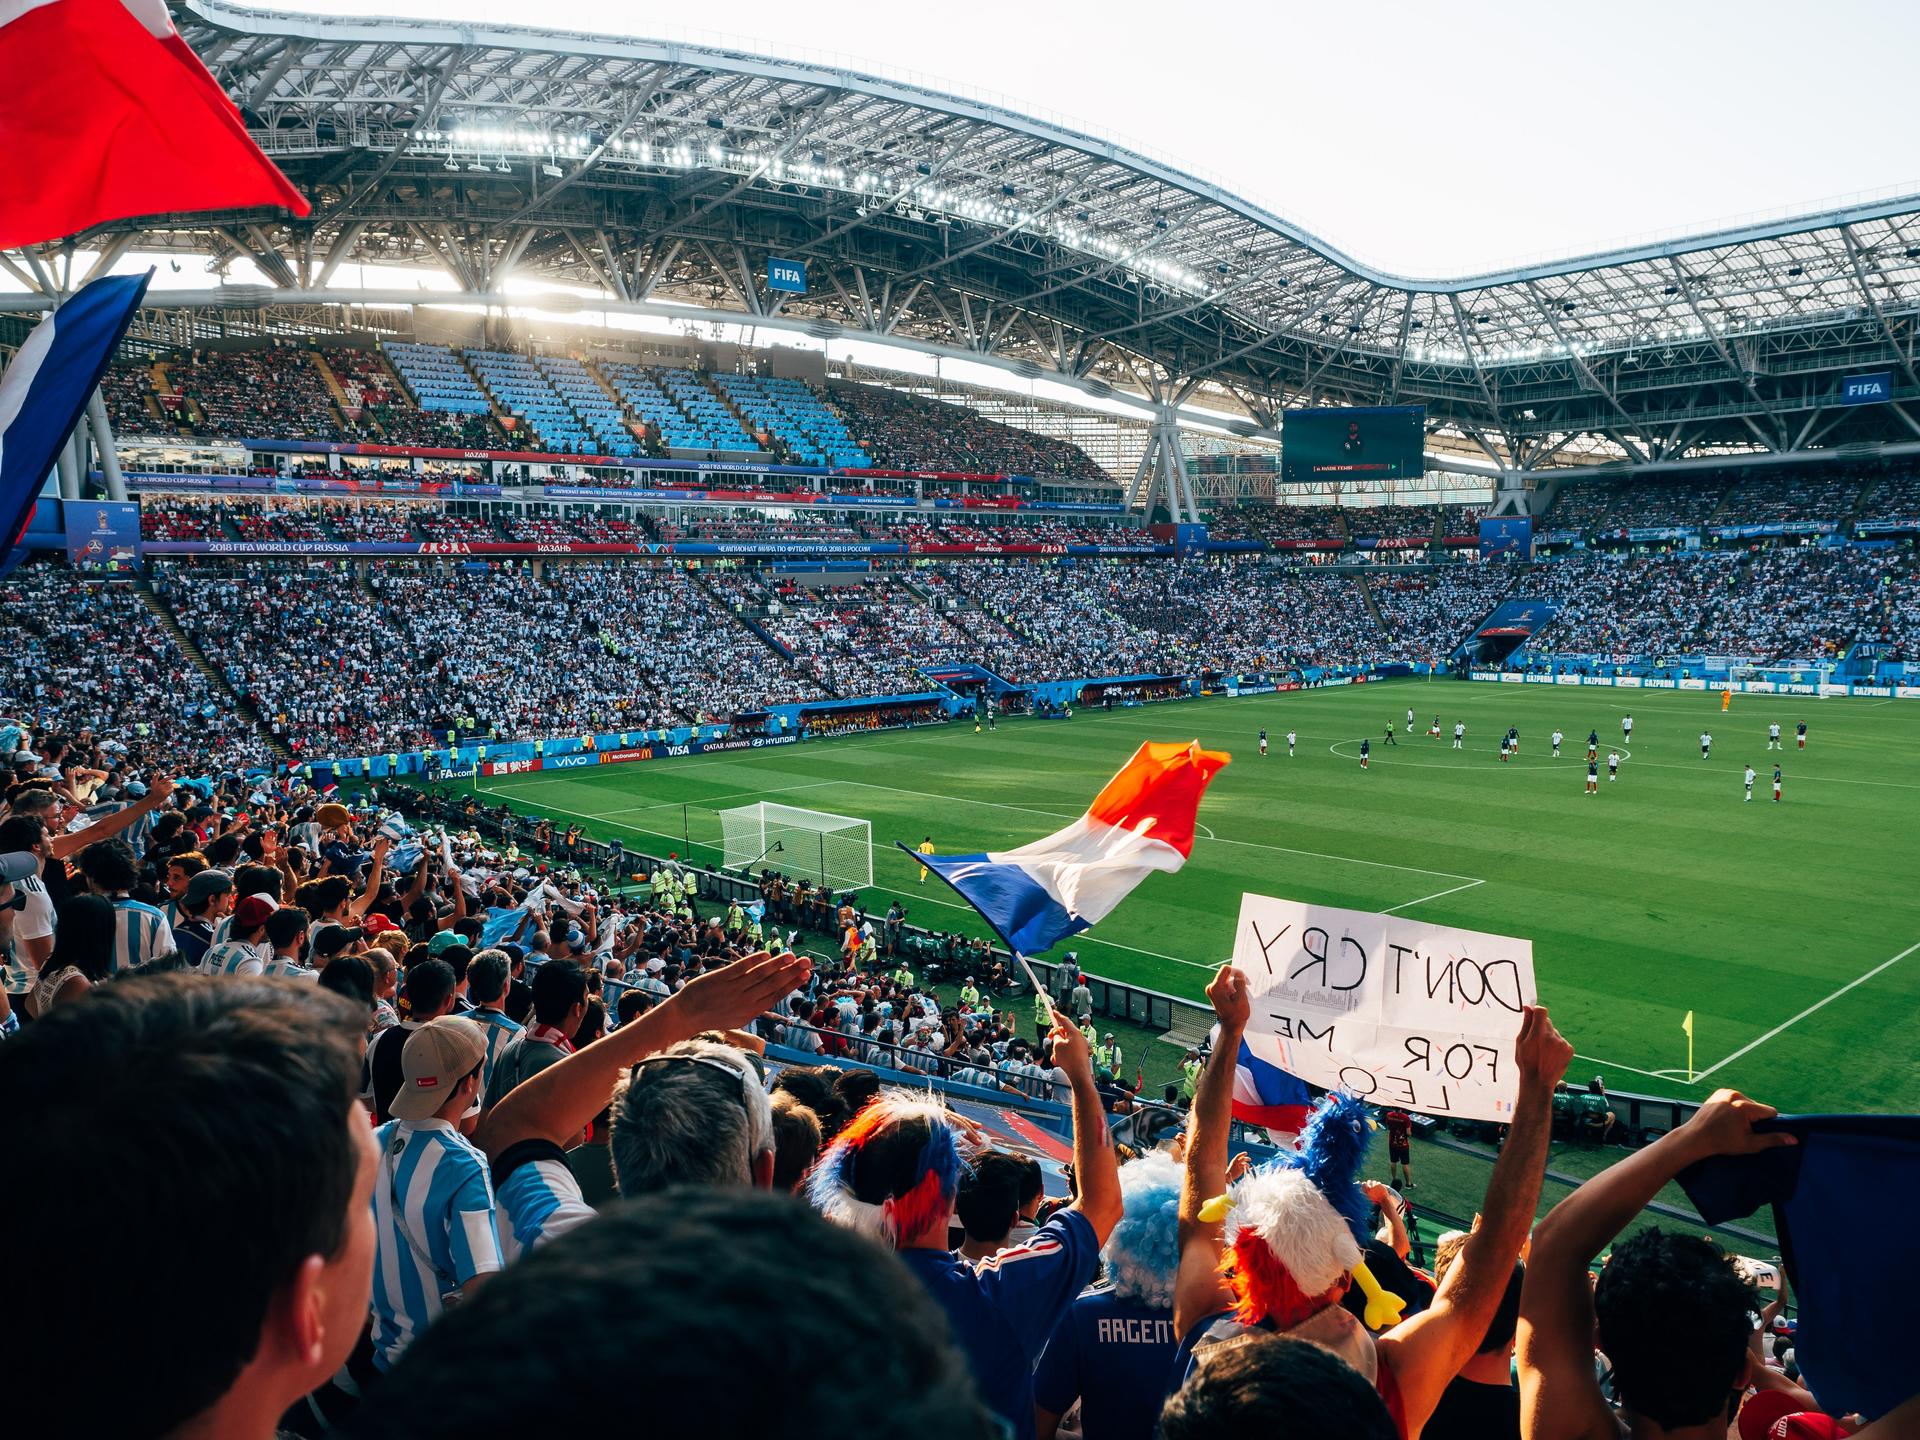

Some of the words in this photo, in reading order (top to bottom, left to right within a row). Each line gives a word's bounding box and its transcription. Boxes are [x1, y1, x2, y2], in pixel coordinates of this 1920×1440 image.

[774, 267, 800, 284] FIFA
[1848, 383, 1882, 396] FIFA
[209, 543, 232, 552] 2018
[233, 543, 255, 552] FIFA
[256, 543, 291, 552] WORLD
[292, 543, 312, 552] CUP
[314, 543, 349, 552] RUSSIA
[537, 544, 571, 552] КАЗАНЬ
[974, 545, 1003, 553] #worldcup
[1472, 672, 1498, 681] GAZPROM
[1853, 687, 1891, 697] GAZPROM
[765, 735, 797, 745] HYUNDAI
[666, 745, 690, 756] VISA
[703, 742, 724, 752] QATAR
[724, 740, 750, 750] AIRWAYS
[555, 755, 587, 767] vivo
[612, 752, 640, 760] McDonald's
